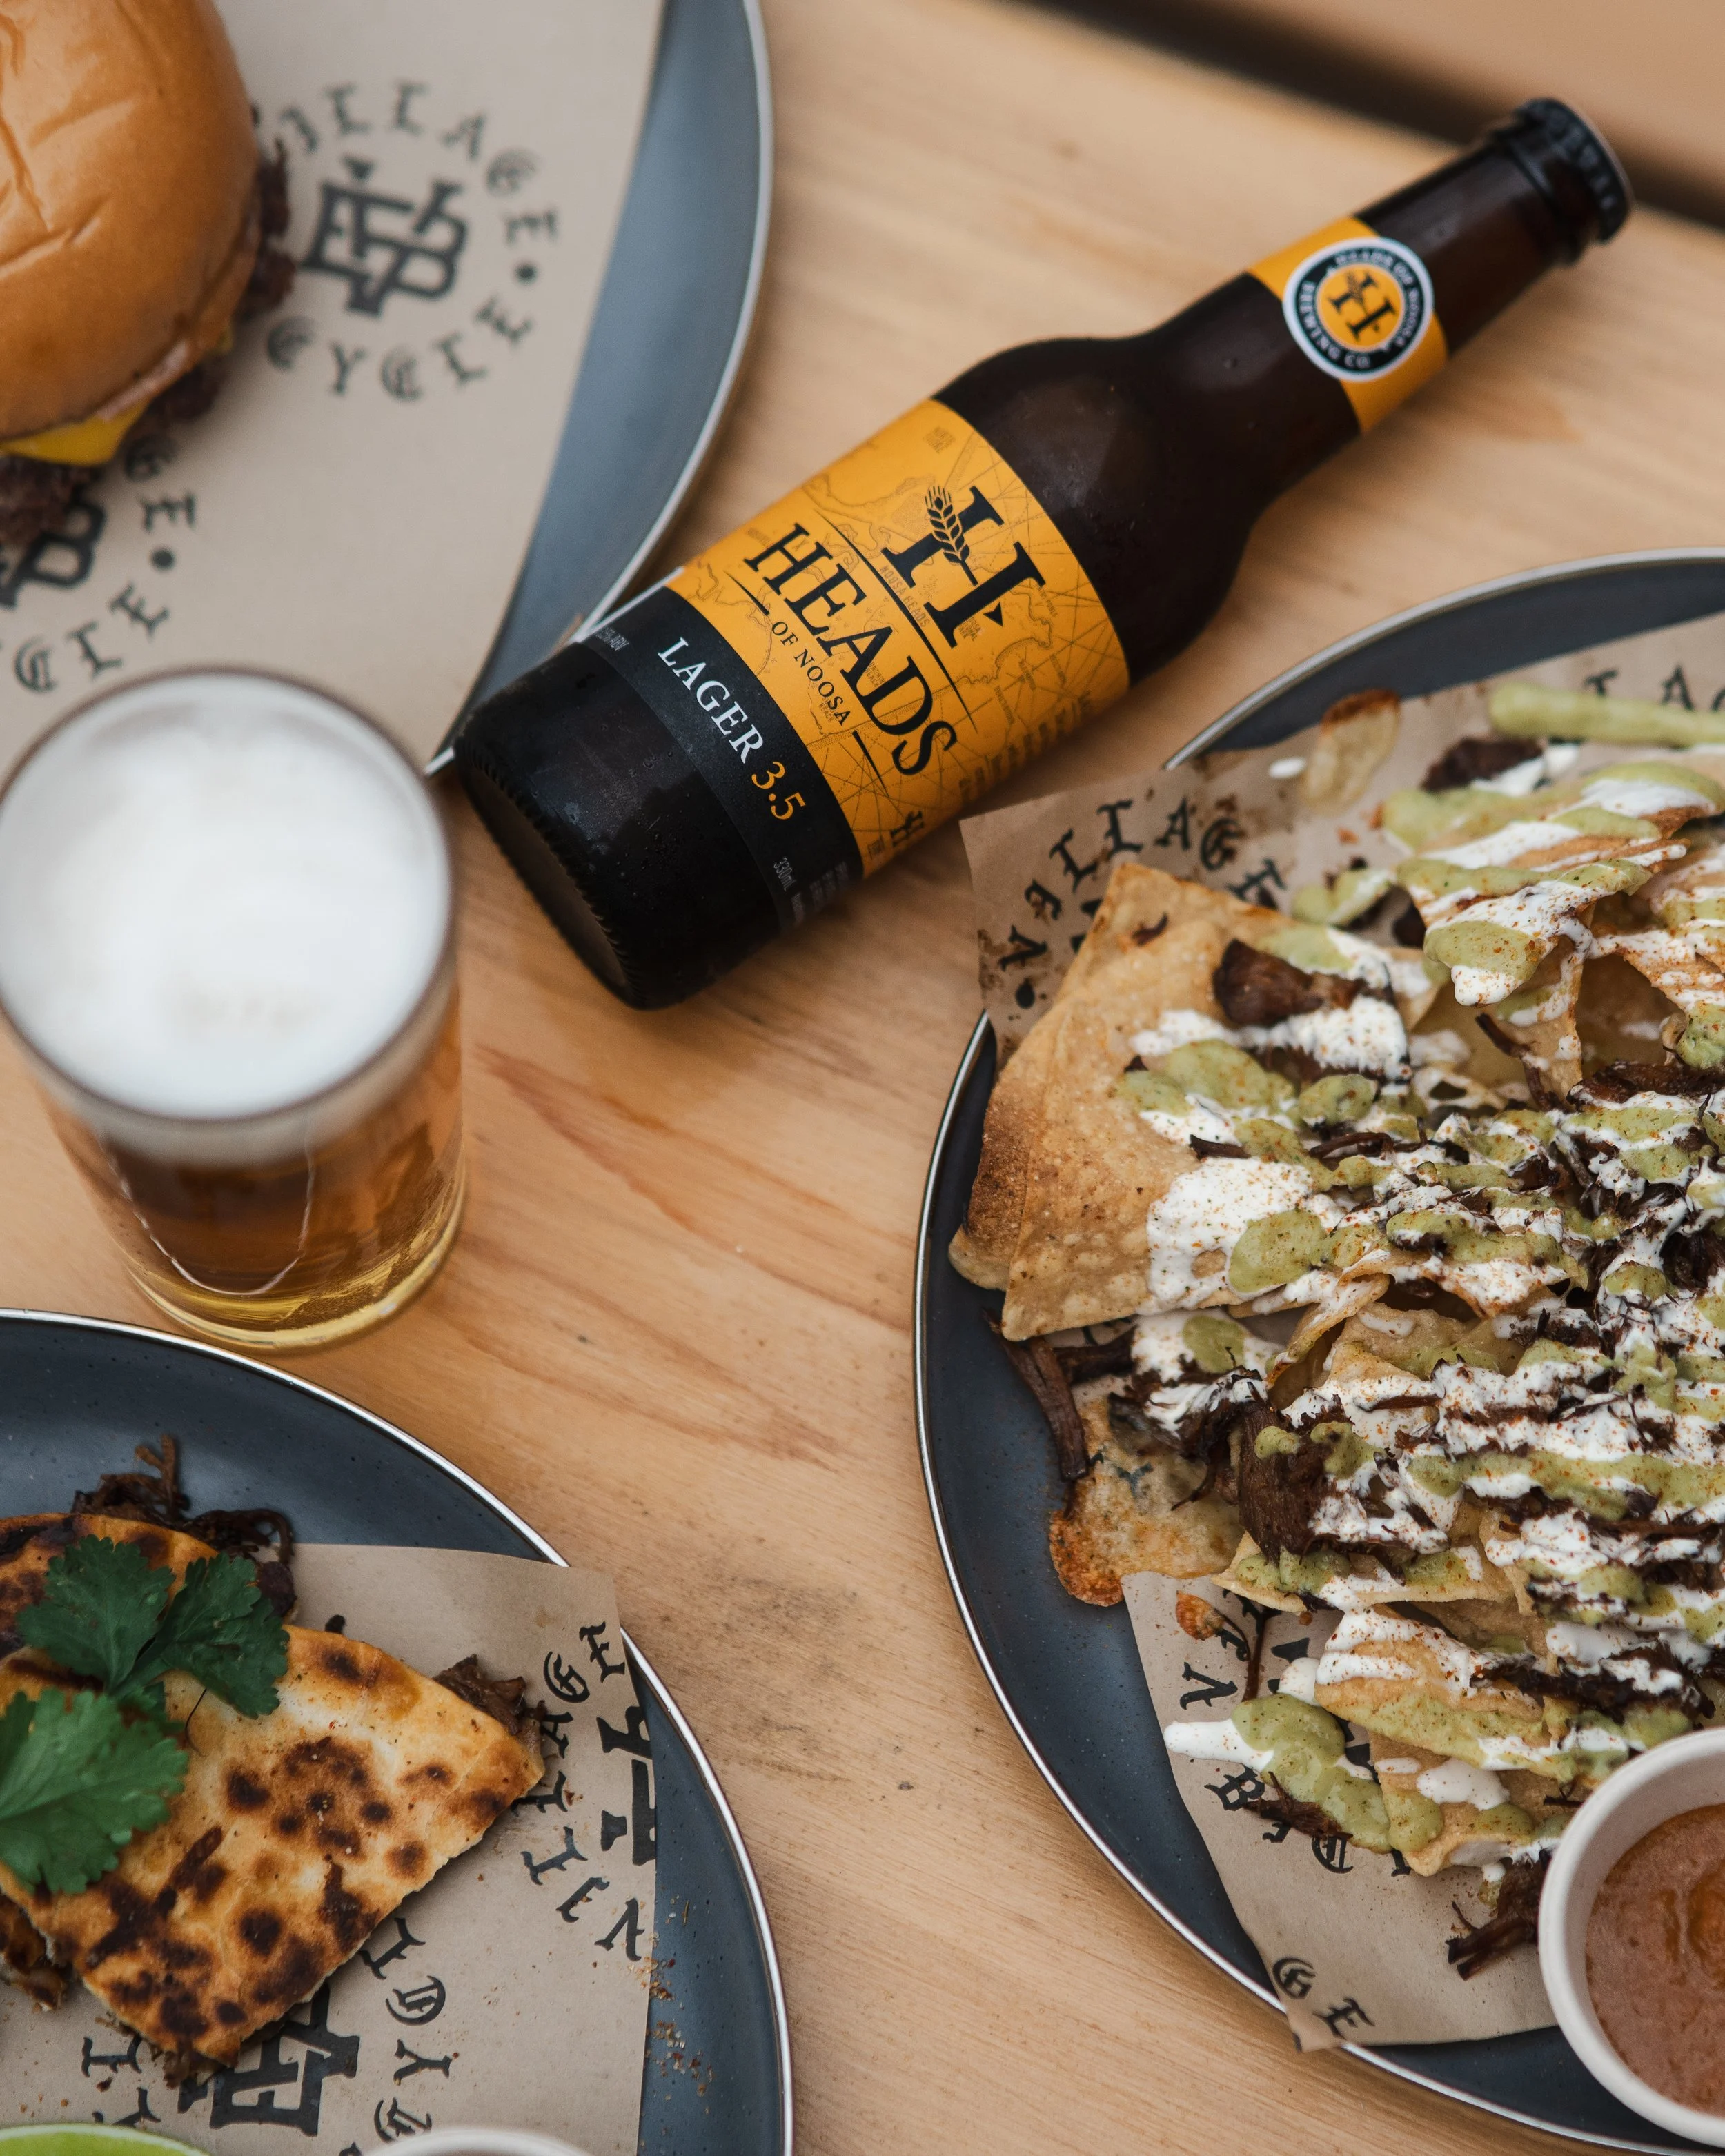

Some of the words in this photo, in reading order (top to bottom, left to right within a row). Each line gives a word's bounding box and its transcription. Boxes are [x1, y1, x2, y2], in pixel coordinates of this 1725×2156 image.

[279, 80, 558, 246] ILLAGE
[267, 295, 531, 401] CYCLE
[880, 485, 1046, 649] H
[880, 564, 904, 599] NOOSA
[903, 595, 931, 628] HEADS
[743, 522, 957, 776] HEADS
[771, 620, 799, 647] OF
[794, 648, 851, 726] NOOSA
[658, 637, 764, 764] LAGER
[751, 761, 806, 820] 3.5
[773, 856, 797, 891] 330mL
